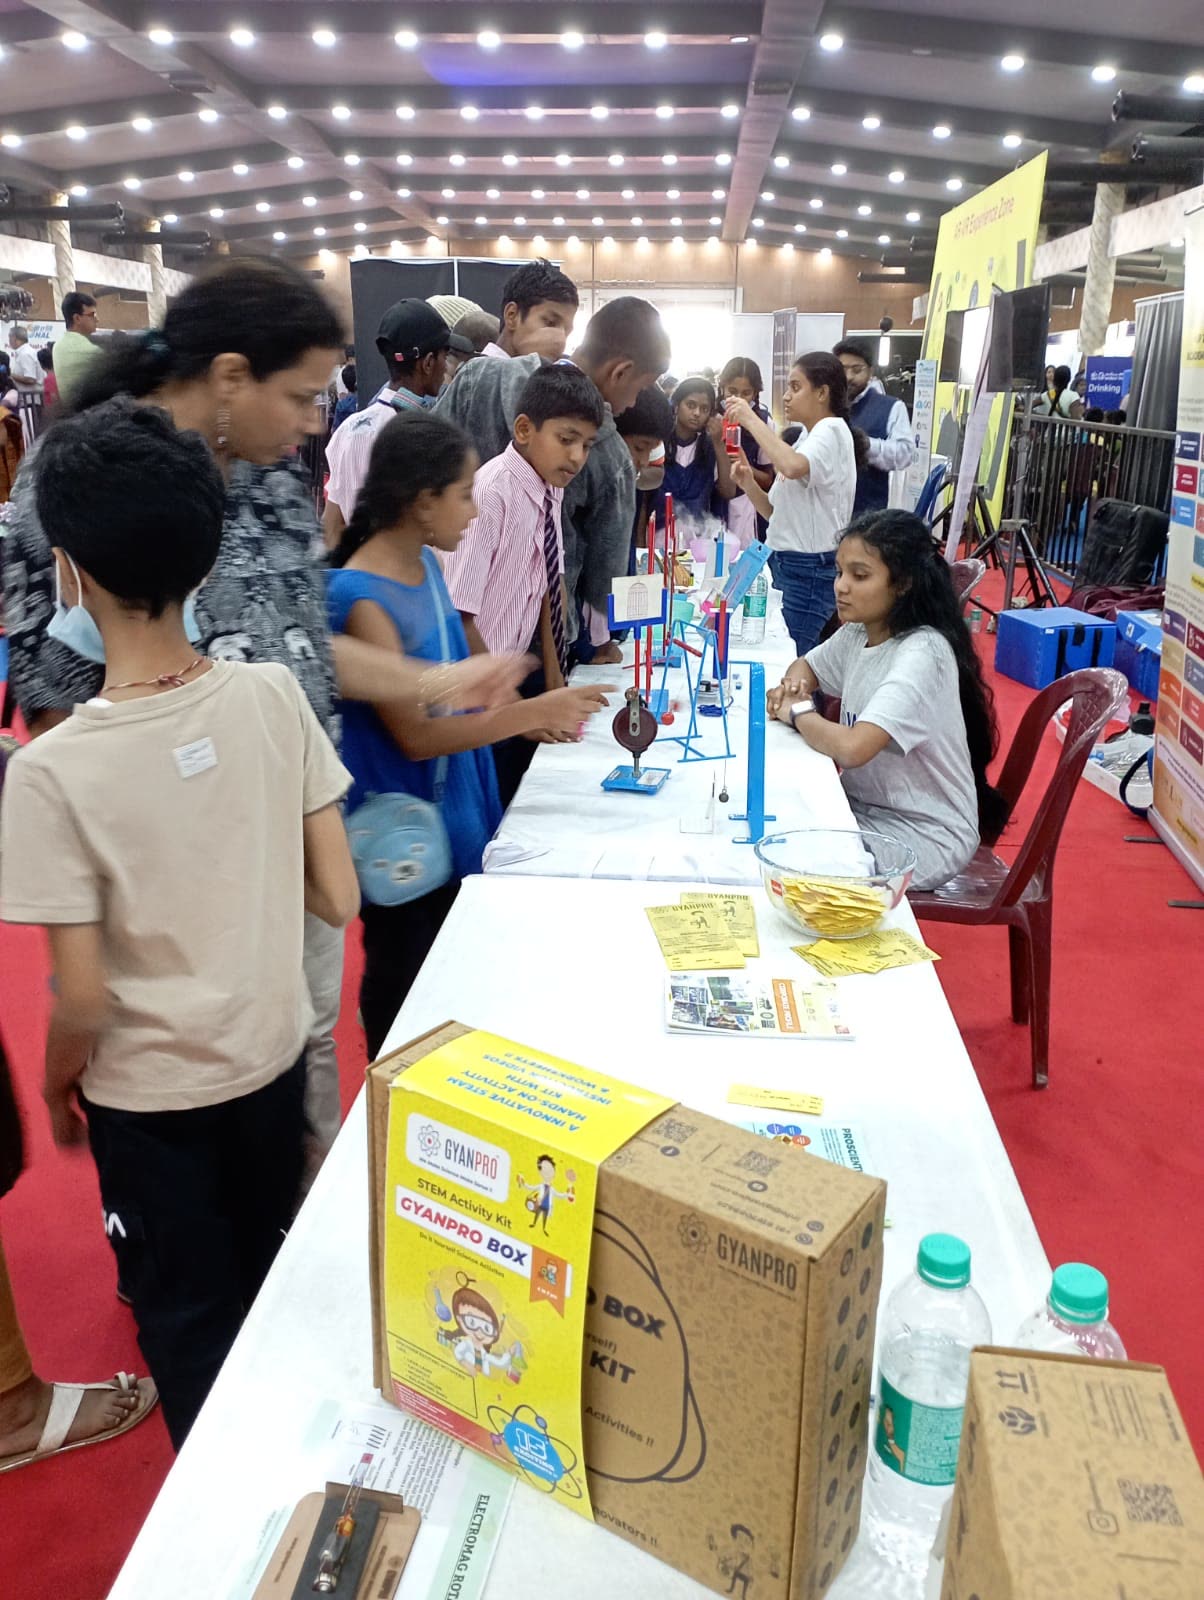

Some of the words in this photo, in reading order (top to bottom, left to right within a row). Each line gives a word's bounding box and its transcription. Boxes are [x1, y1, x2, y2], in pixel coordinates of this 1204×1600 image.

[1088, 383, 1121, 395] Drinking
[447, 1076, 489, 1097] STEAM
[461, 1069, 515, 1094] ACTIVITY
[505, 1073, 536, 1088] WITH
[543, 1089, 563, 1099] KIT
[487, 1092, 567, 1127] INNOVATIVE
[567, 1123, 580, 1133] A
[444, 1138, 498, 1181] GYANPRO
[842, 1127, 864, 1173] PROSCIENT
[417, 1177, 447, 1200] STEM
[450, 1189, 493, 1223] Activity
[496, 1209, 513, 1230] Kit
[400, 1196, 484, 1244] GYANPRO
[486, 1237, 529, 1267] BOX
[717, 1232, 797, 1292] GYANPRO
[602, 1295, 667, 1342] BOX
[585, 1332, 618, 1353] rself)
[589, 1350, 636, 1384] KIT
[584, 1405, 644, 1443] Activities
[456, 1493, 491, 1572] ELECTROMAG
[592, 1505, 648, 1542] novators
